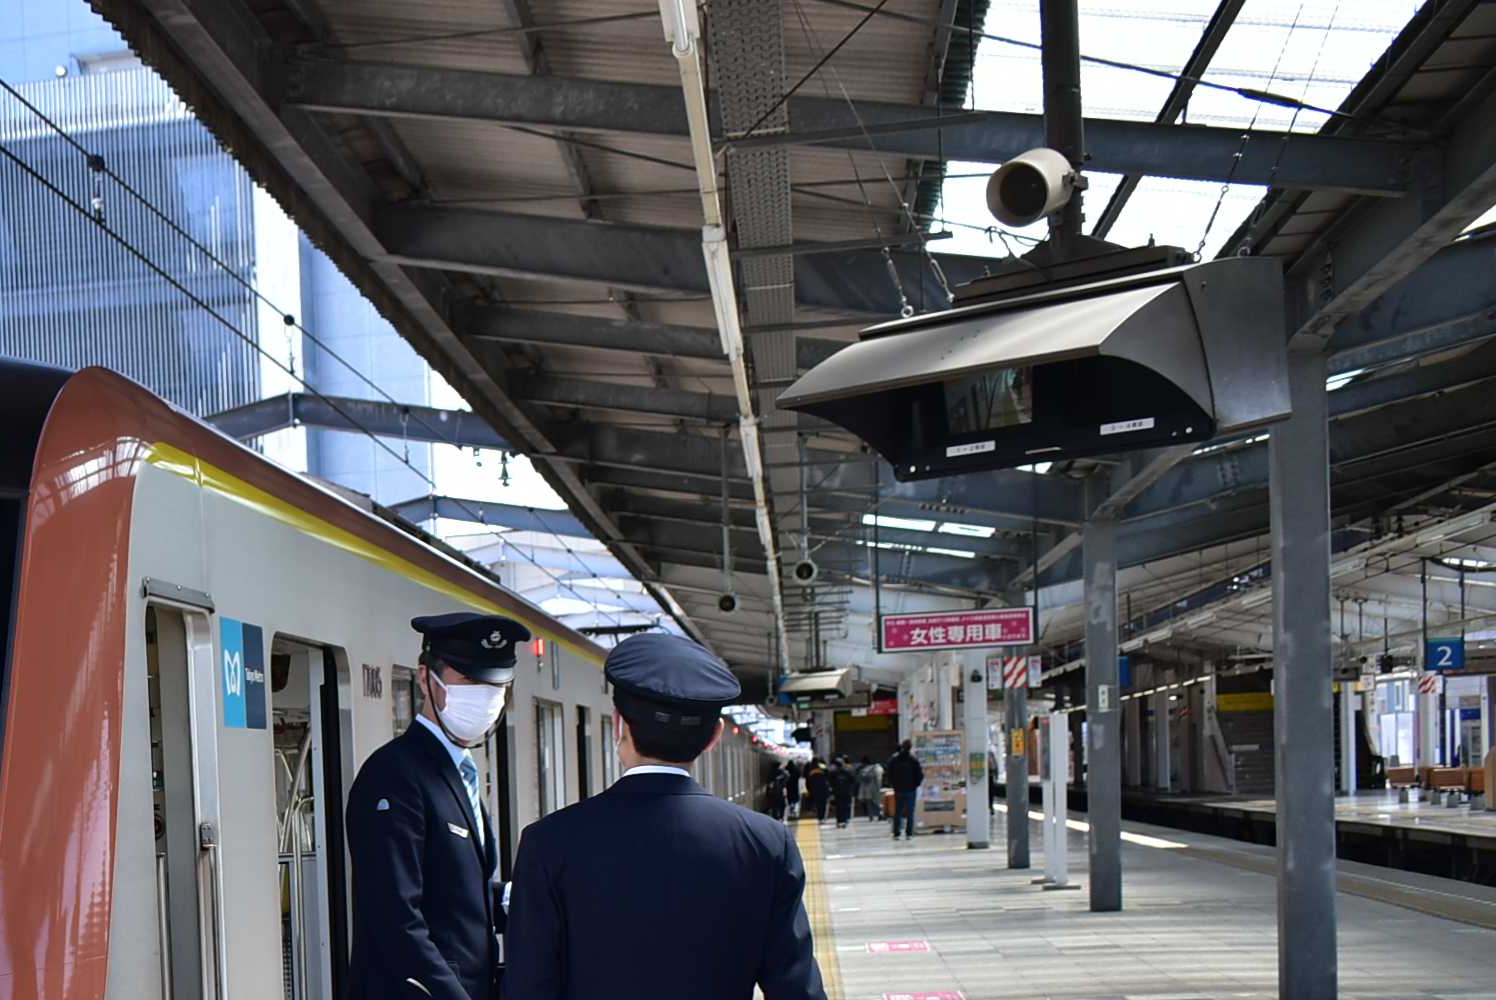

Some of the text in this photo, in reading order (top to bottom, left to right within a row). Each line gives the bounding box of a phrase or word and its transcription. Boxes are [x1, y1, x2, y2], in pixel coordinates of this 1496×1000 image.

[910, 623, 1002, 645] 女性専用車
[1437, 646, 1452, 666] 2
